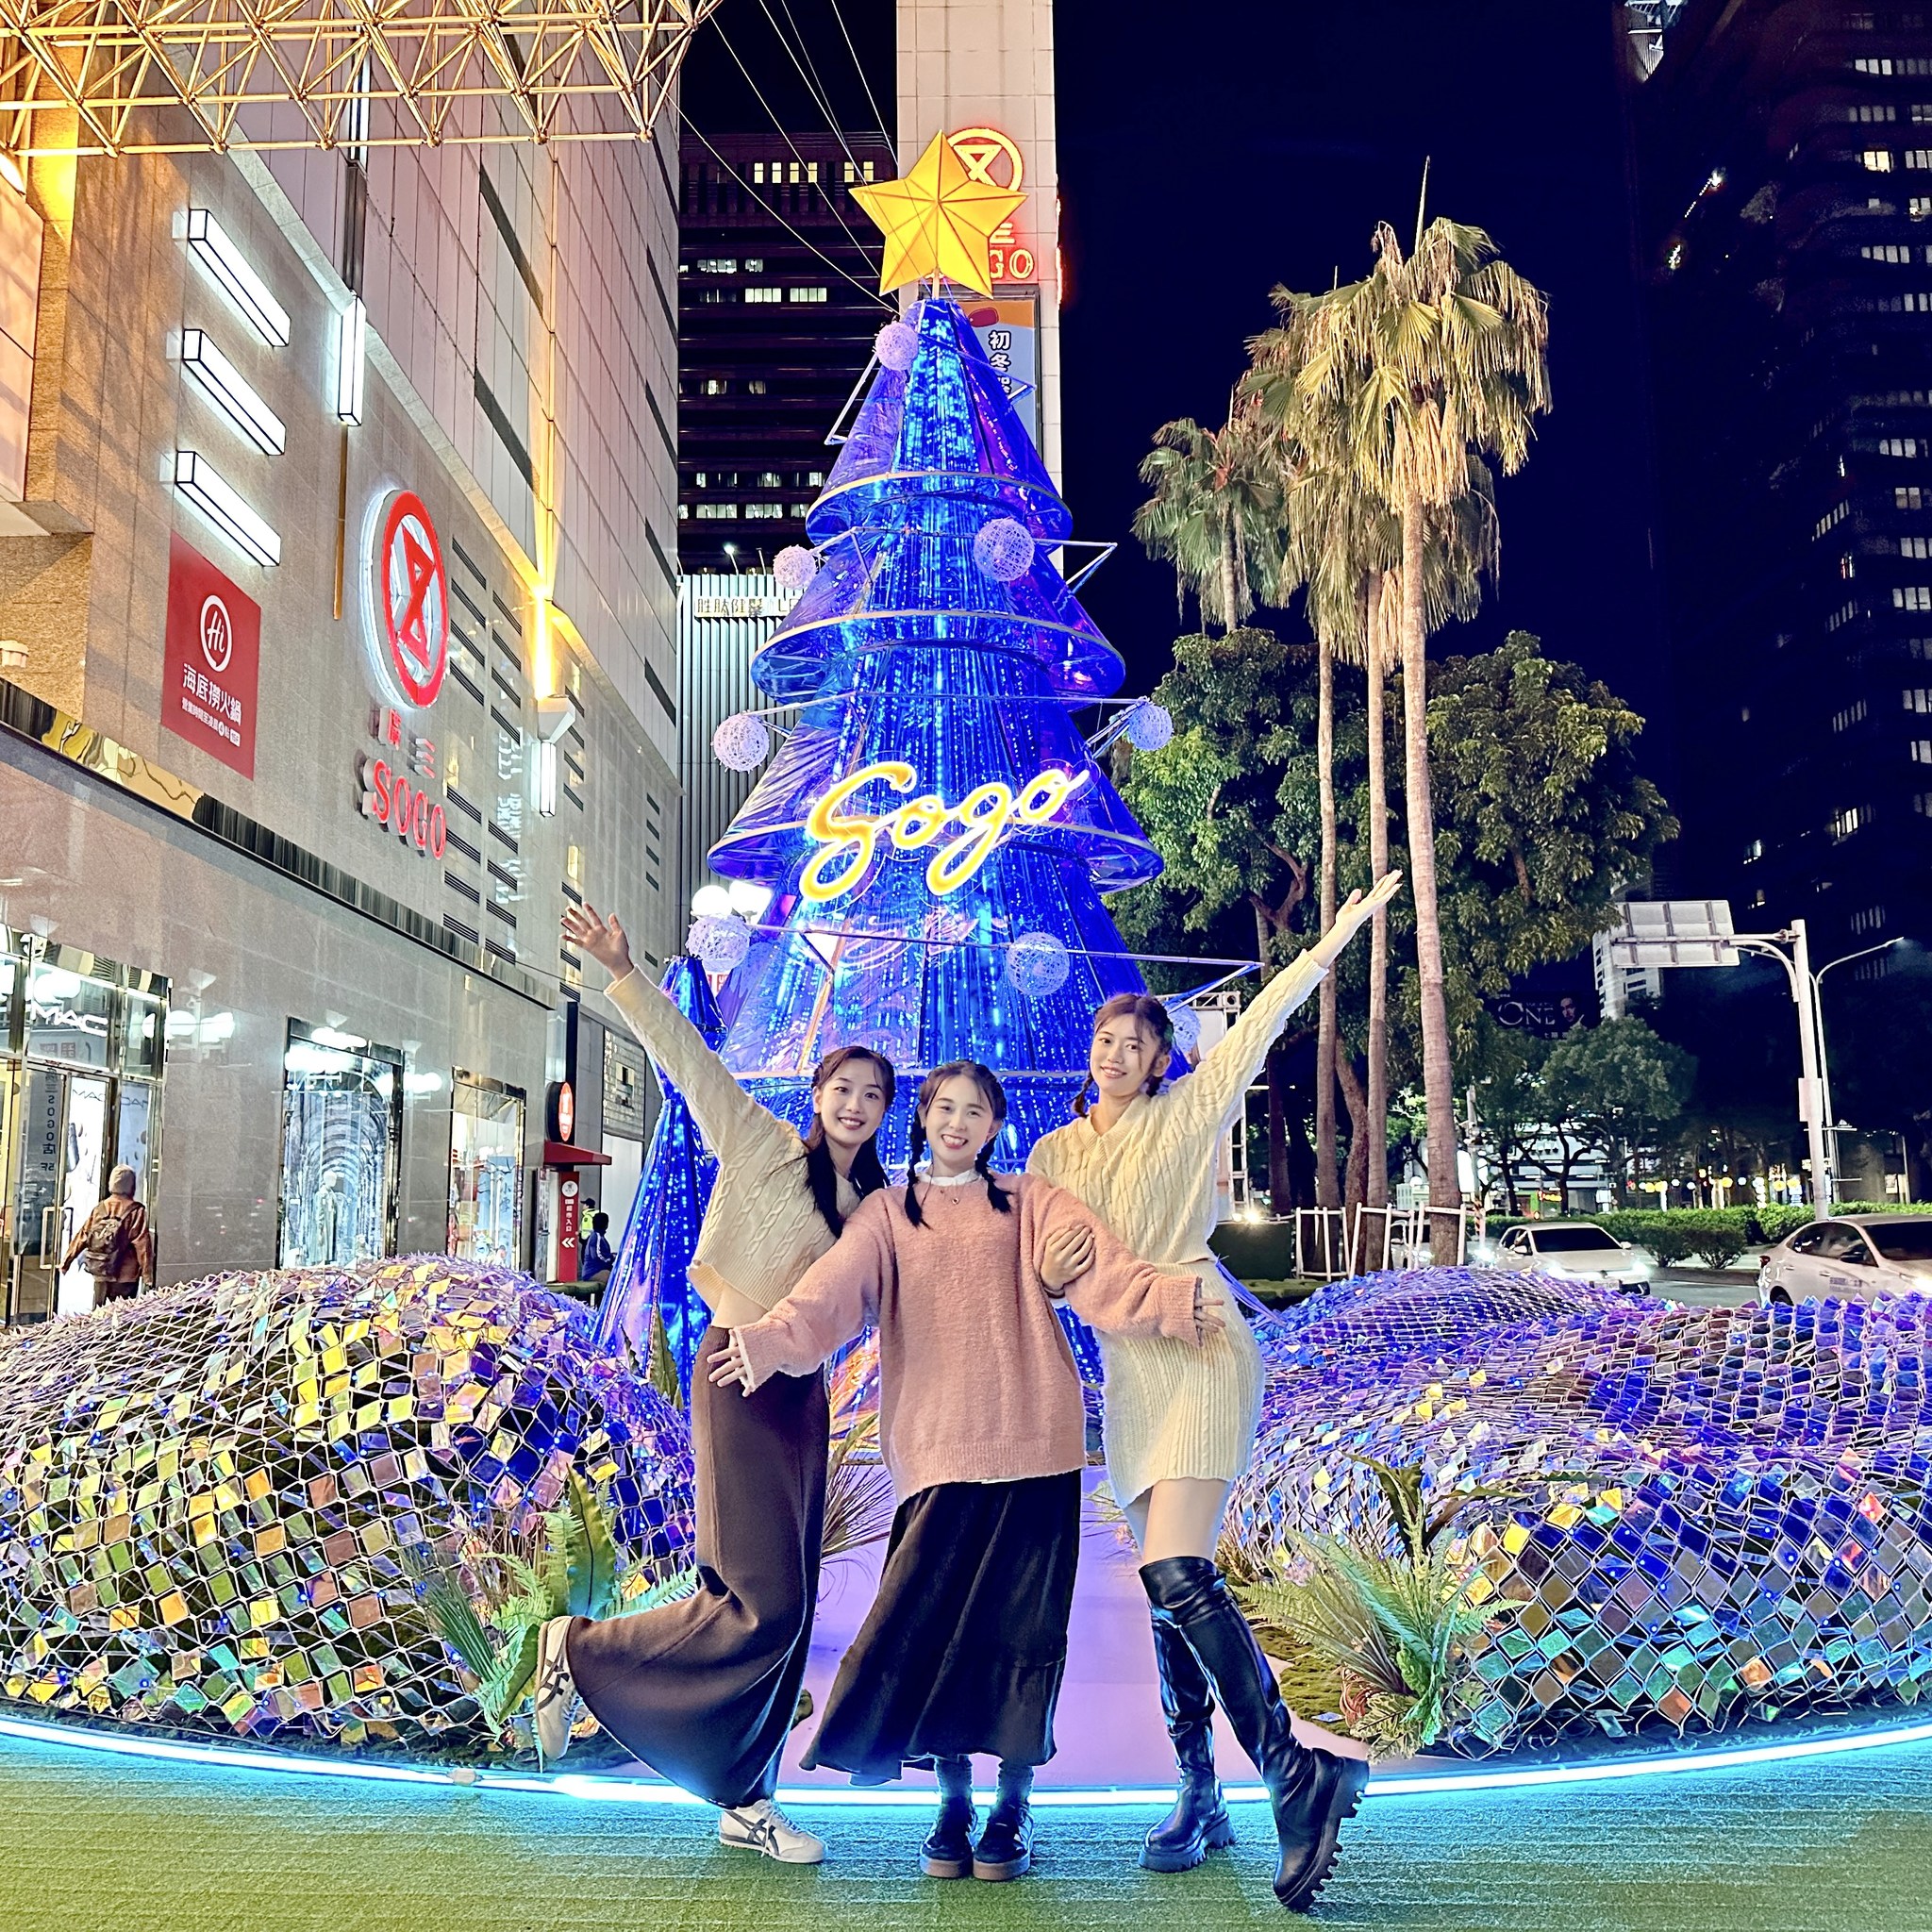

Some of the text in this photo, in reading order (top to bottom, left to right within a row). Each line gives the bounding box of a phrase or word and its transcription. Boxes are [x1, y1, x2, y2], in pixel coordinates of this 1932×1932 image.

[990, 249, 1034, 279] GO
[183, 663, 242, 726] 海底撈火鍋
[371, 759, 447, 860] SOGO
[800, 761, 1090, 901] Sogo
